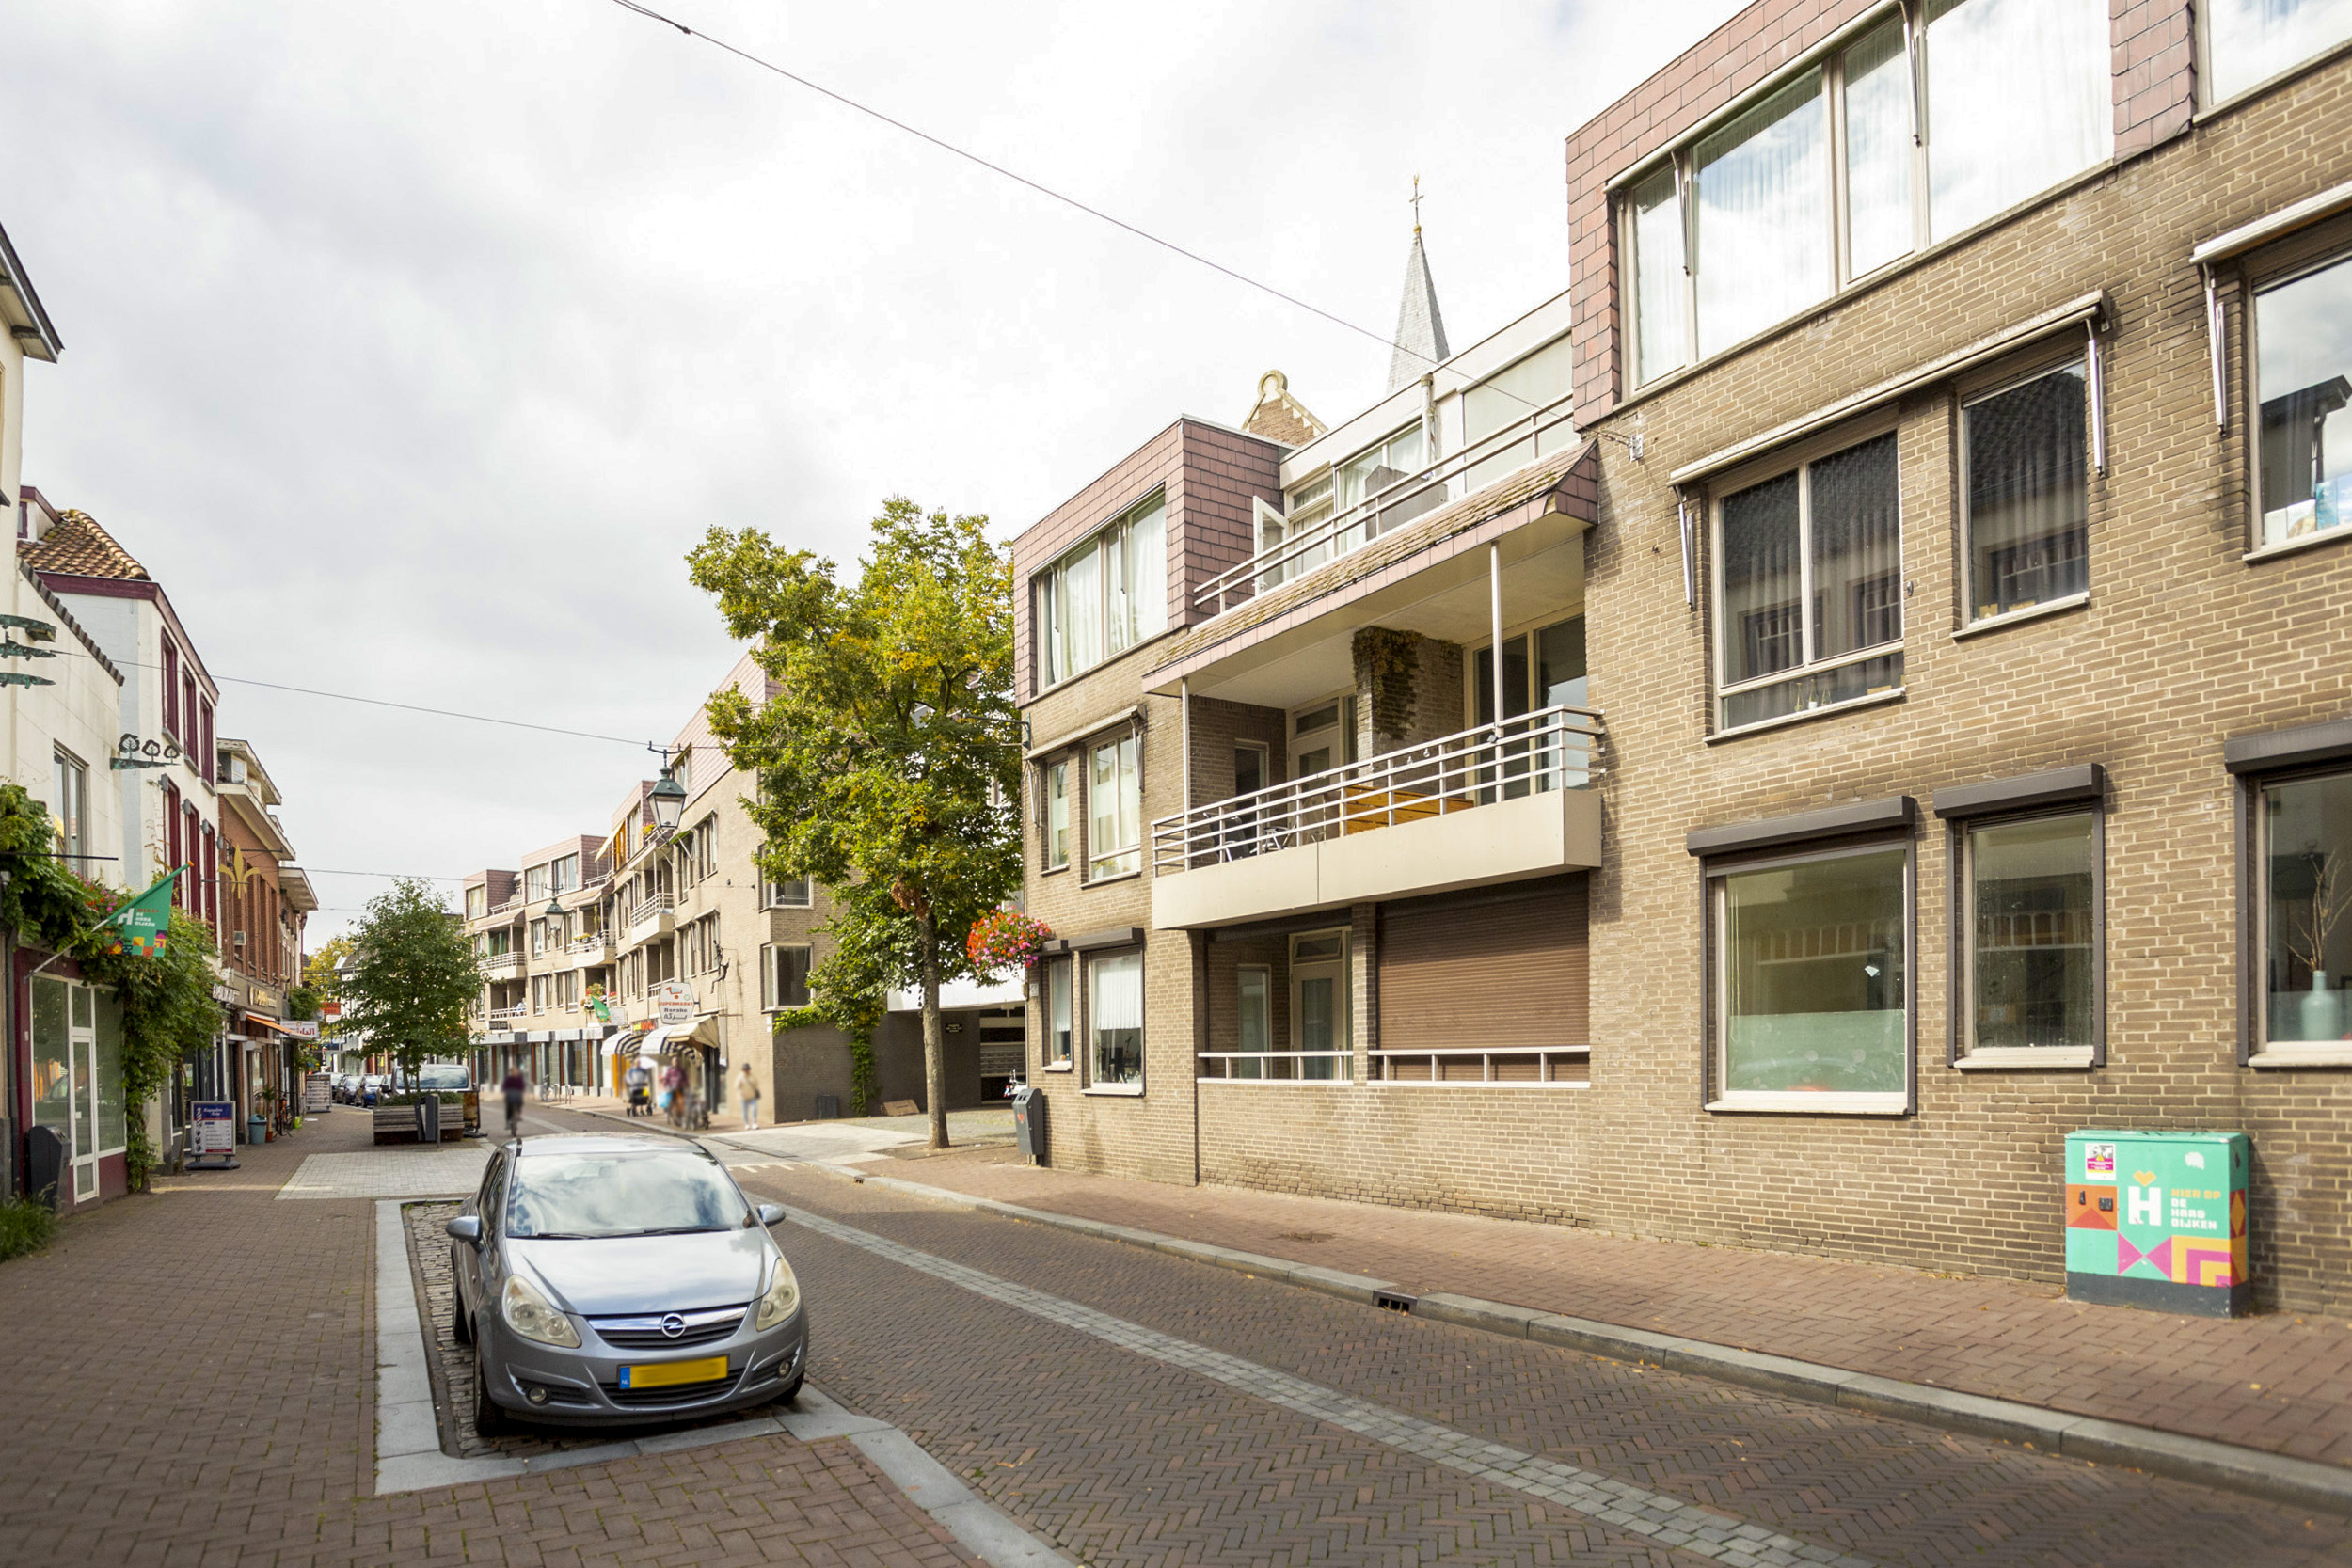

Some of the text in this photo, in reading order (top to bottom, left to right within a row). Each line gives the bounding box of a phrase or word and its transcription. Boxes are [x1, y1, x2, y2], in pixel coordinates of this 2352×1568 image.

[2171, 1188, 2221, 1200] HIER OP
[2170, 1198, 2187, 1208] DE
[2170, 1218, 2217, 1230] DIJKEN
